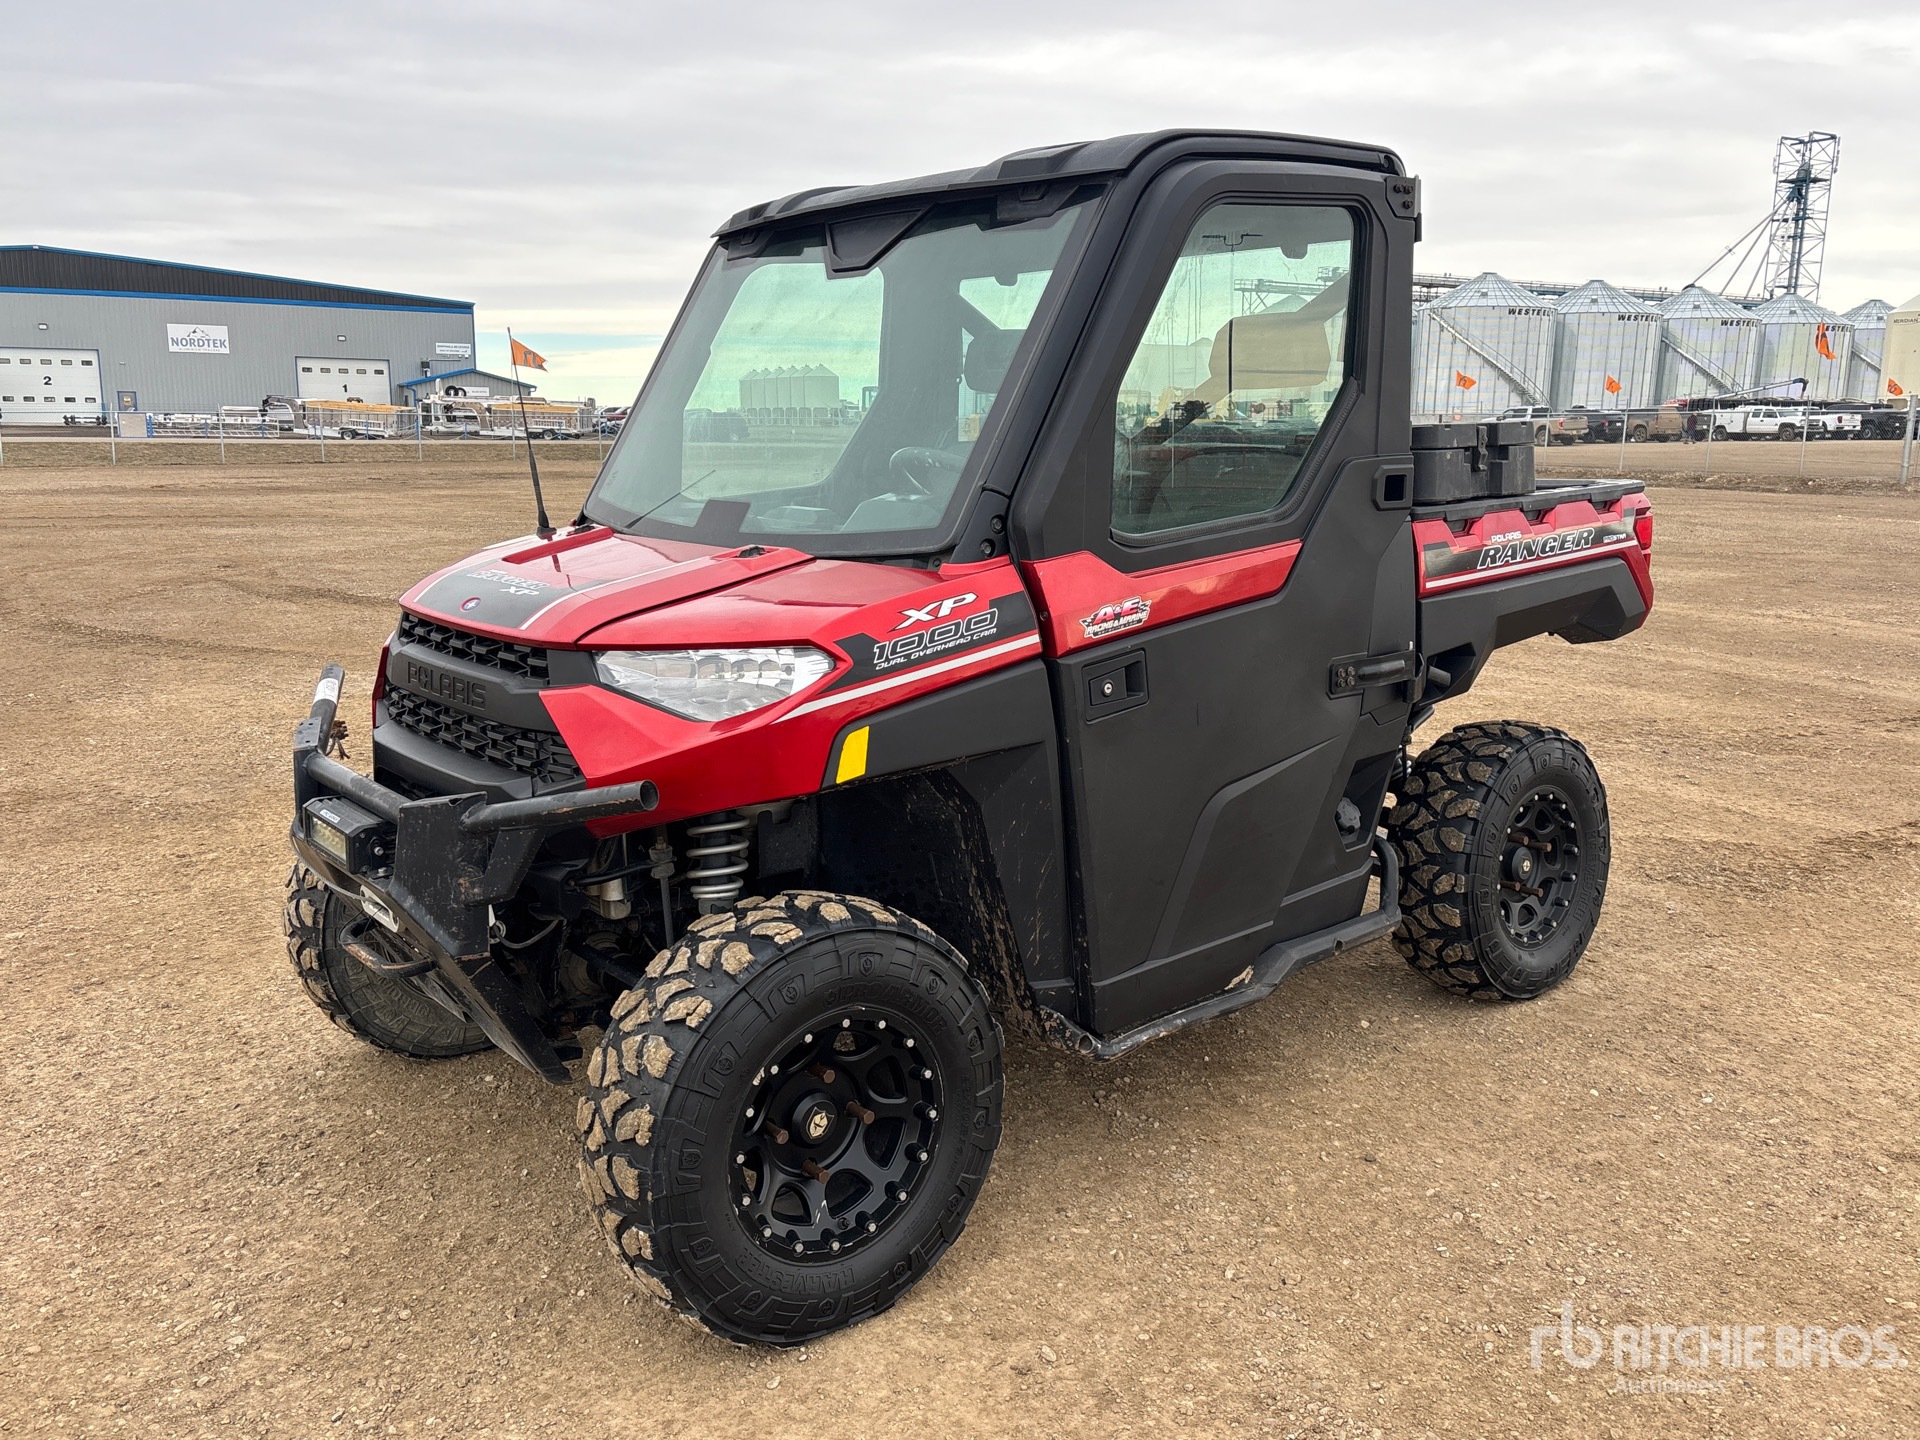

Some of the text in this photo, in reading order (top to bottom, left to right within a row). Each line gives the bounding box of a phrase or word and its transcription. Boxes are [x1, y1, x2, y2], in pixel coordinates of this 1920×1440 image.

[170, 337, 228, 349] NORDTEK
[43, 376, 52, 386] 2
[342, 384, 348, 393] 1
[1477, 528, 1595, 570] RANGER
[1490, 531, 1522, 543] POLARIS
[891, 592, 979, 630] XP
[873, 608, 999, 664] 1000
[875, 627, 997, 671] DUAL OVERHEAD CAM
[407, 661, 487, 711] POLARIS
